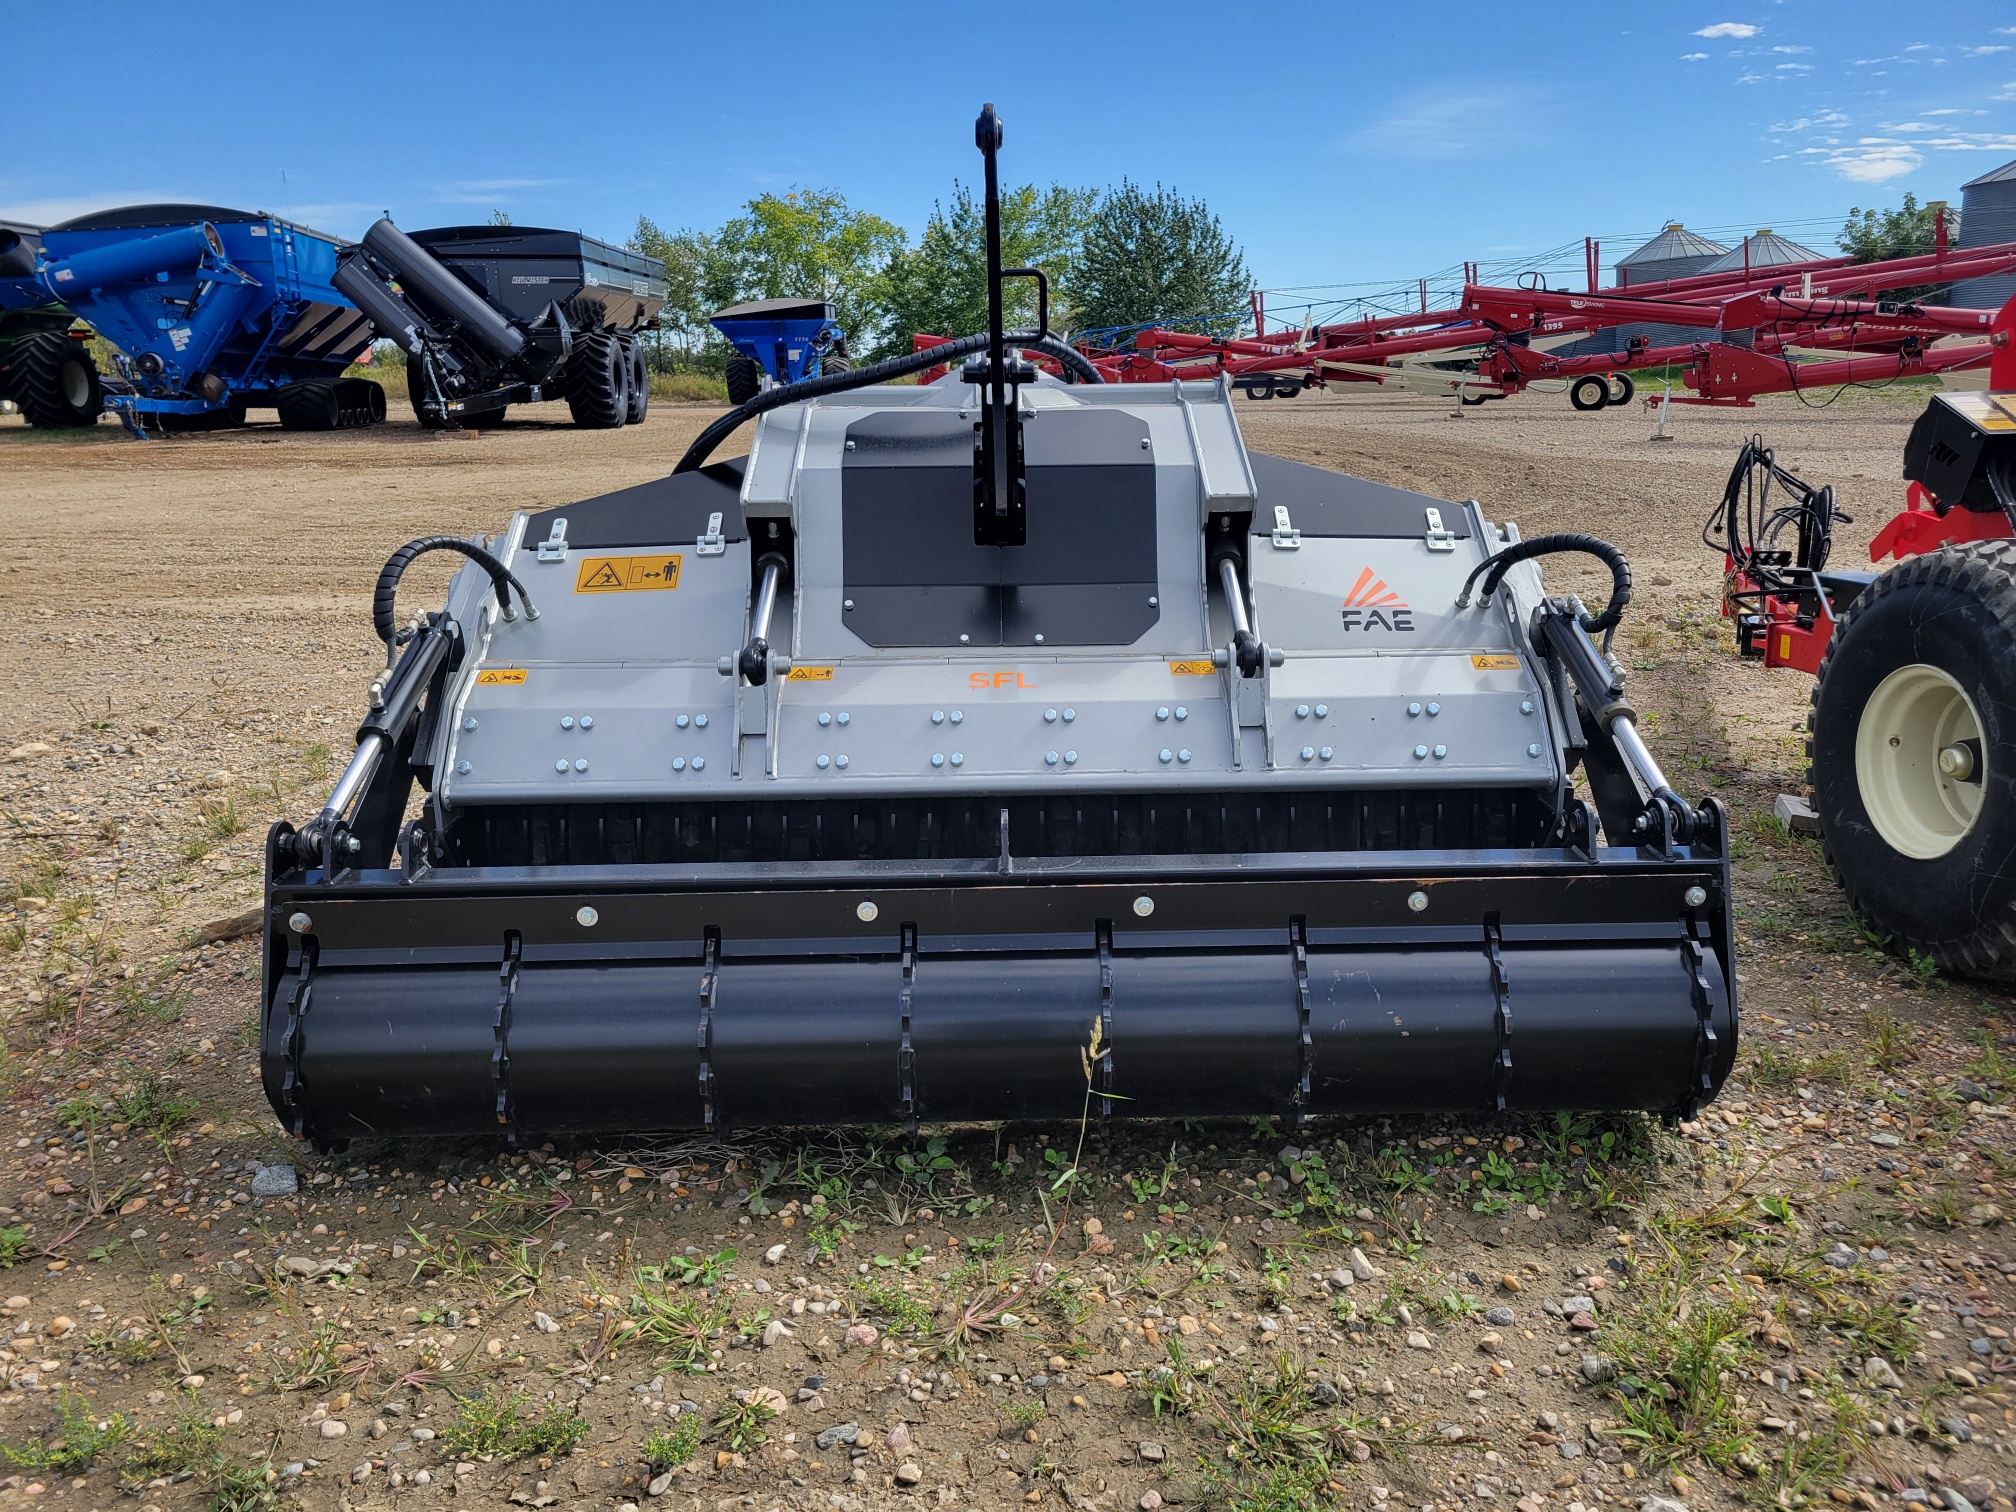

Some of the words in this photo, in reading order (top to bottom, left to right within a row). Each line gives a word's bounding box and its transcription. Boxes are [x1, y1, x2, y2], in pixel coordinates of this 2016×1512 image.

[1543, 321, 1563, 331] 1395
[1852, 321, 1896, 331] Farm
[1341, 609, 1415, 632] FAE
[968, 671, 1037, 689] SFL
